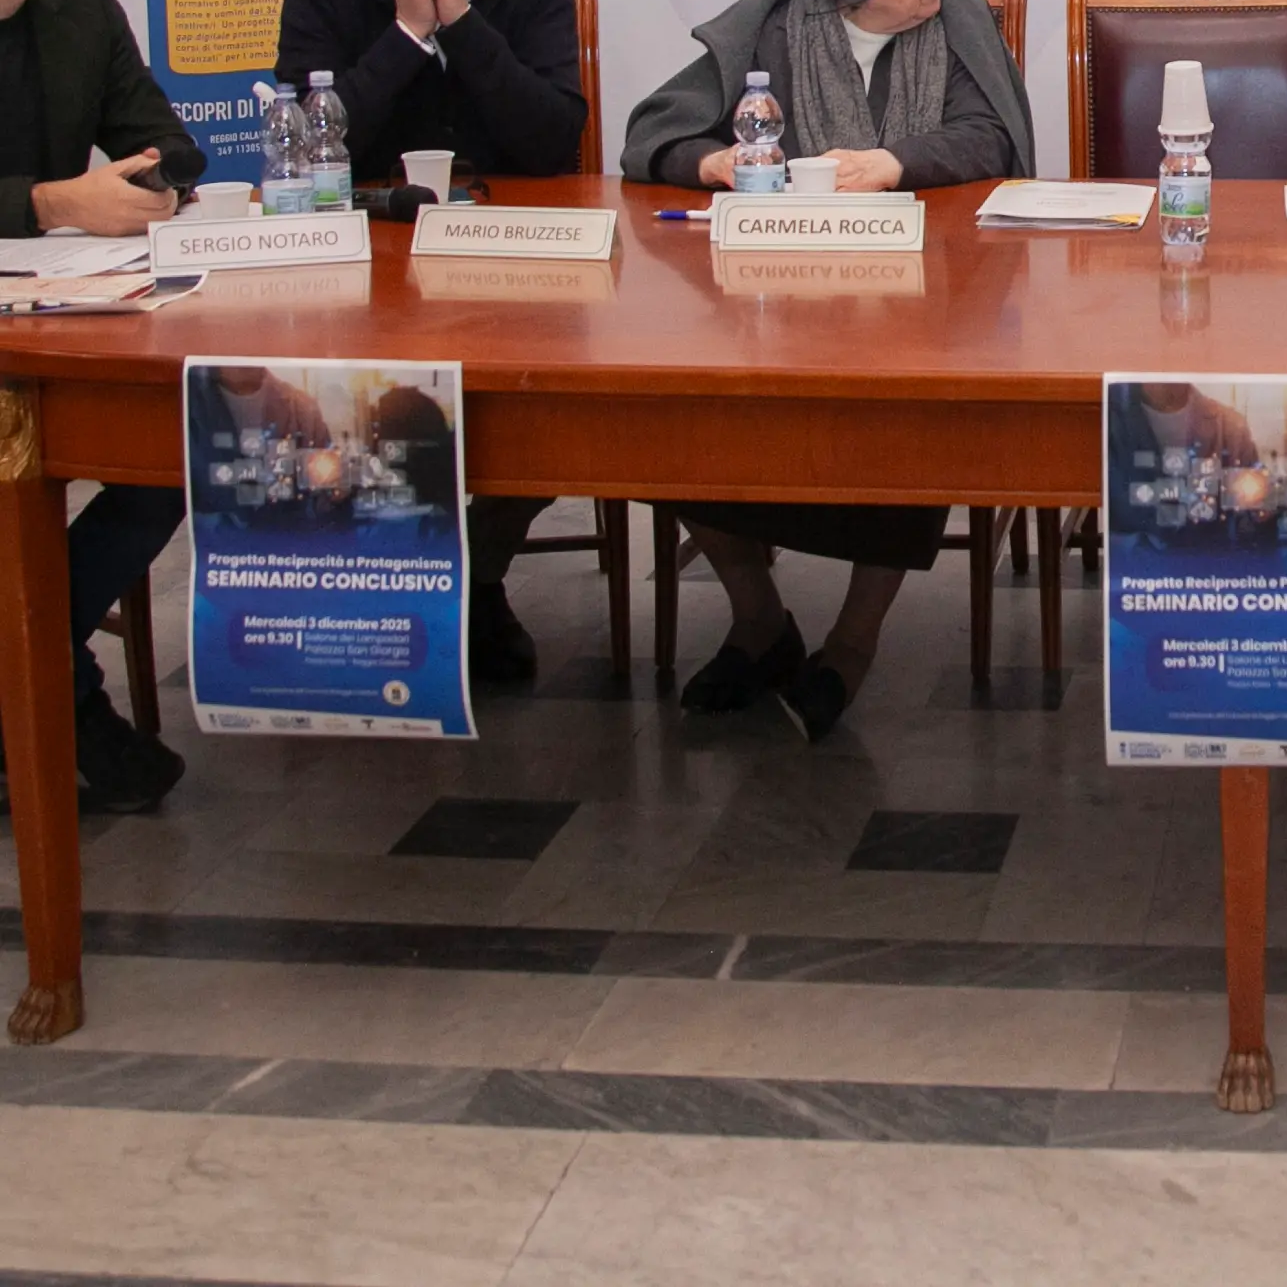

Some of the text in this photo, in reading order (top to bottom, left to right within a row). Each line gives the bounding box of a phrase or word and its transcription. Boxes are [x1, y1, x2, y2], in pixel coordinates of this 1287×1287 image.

[238, 18, 275, 29] progetto
[171, 101, 232, 122] SCOPRI
[238, 99, 254, 119] DI
[210, 133, 238, 144] REGGIO
[236, 144, 261, 155] 11305
[445, 224, 582, 241] MARIO BRUZZESE
[738, 218, 906, 235] CARMELA ROCCA
[180, 230, 338, 255] SERGIO NOTARO
[208, 553, 266, 567] Progetto
[268, 553, 344, 569] Reciprocità
[357, 556, 452, 573] Protagonismo
[207, 570, 452, 592] SEMINARIO CONCLUSIVO
[1122, 576, 1183, 591] Progetto
[1186, 576, 1266, 592] Reciprocità
[1122, 593, 1239, 611] SEMINARIO
[308, 617, 316, 629] 3
[318, 617, 379, 630] dicembre
[380, 618, 411, 631] 2025
[244, 633, 266, 644] ore
[1231, 639, 1239, 651] 3
[1163, 657, 1186, 669] ore
